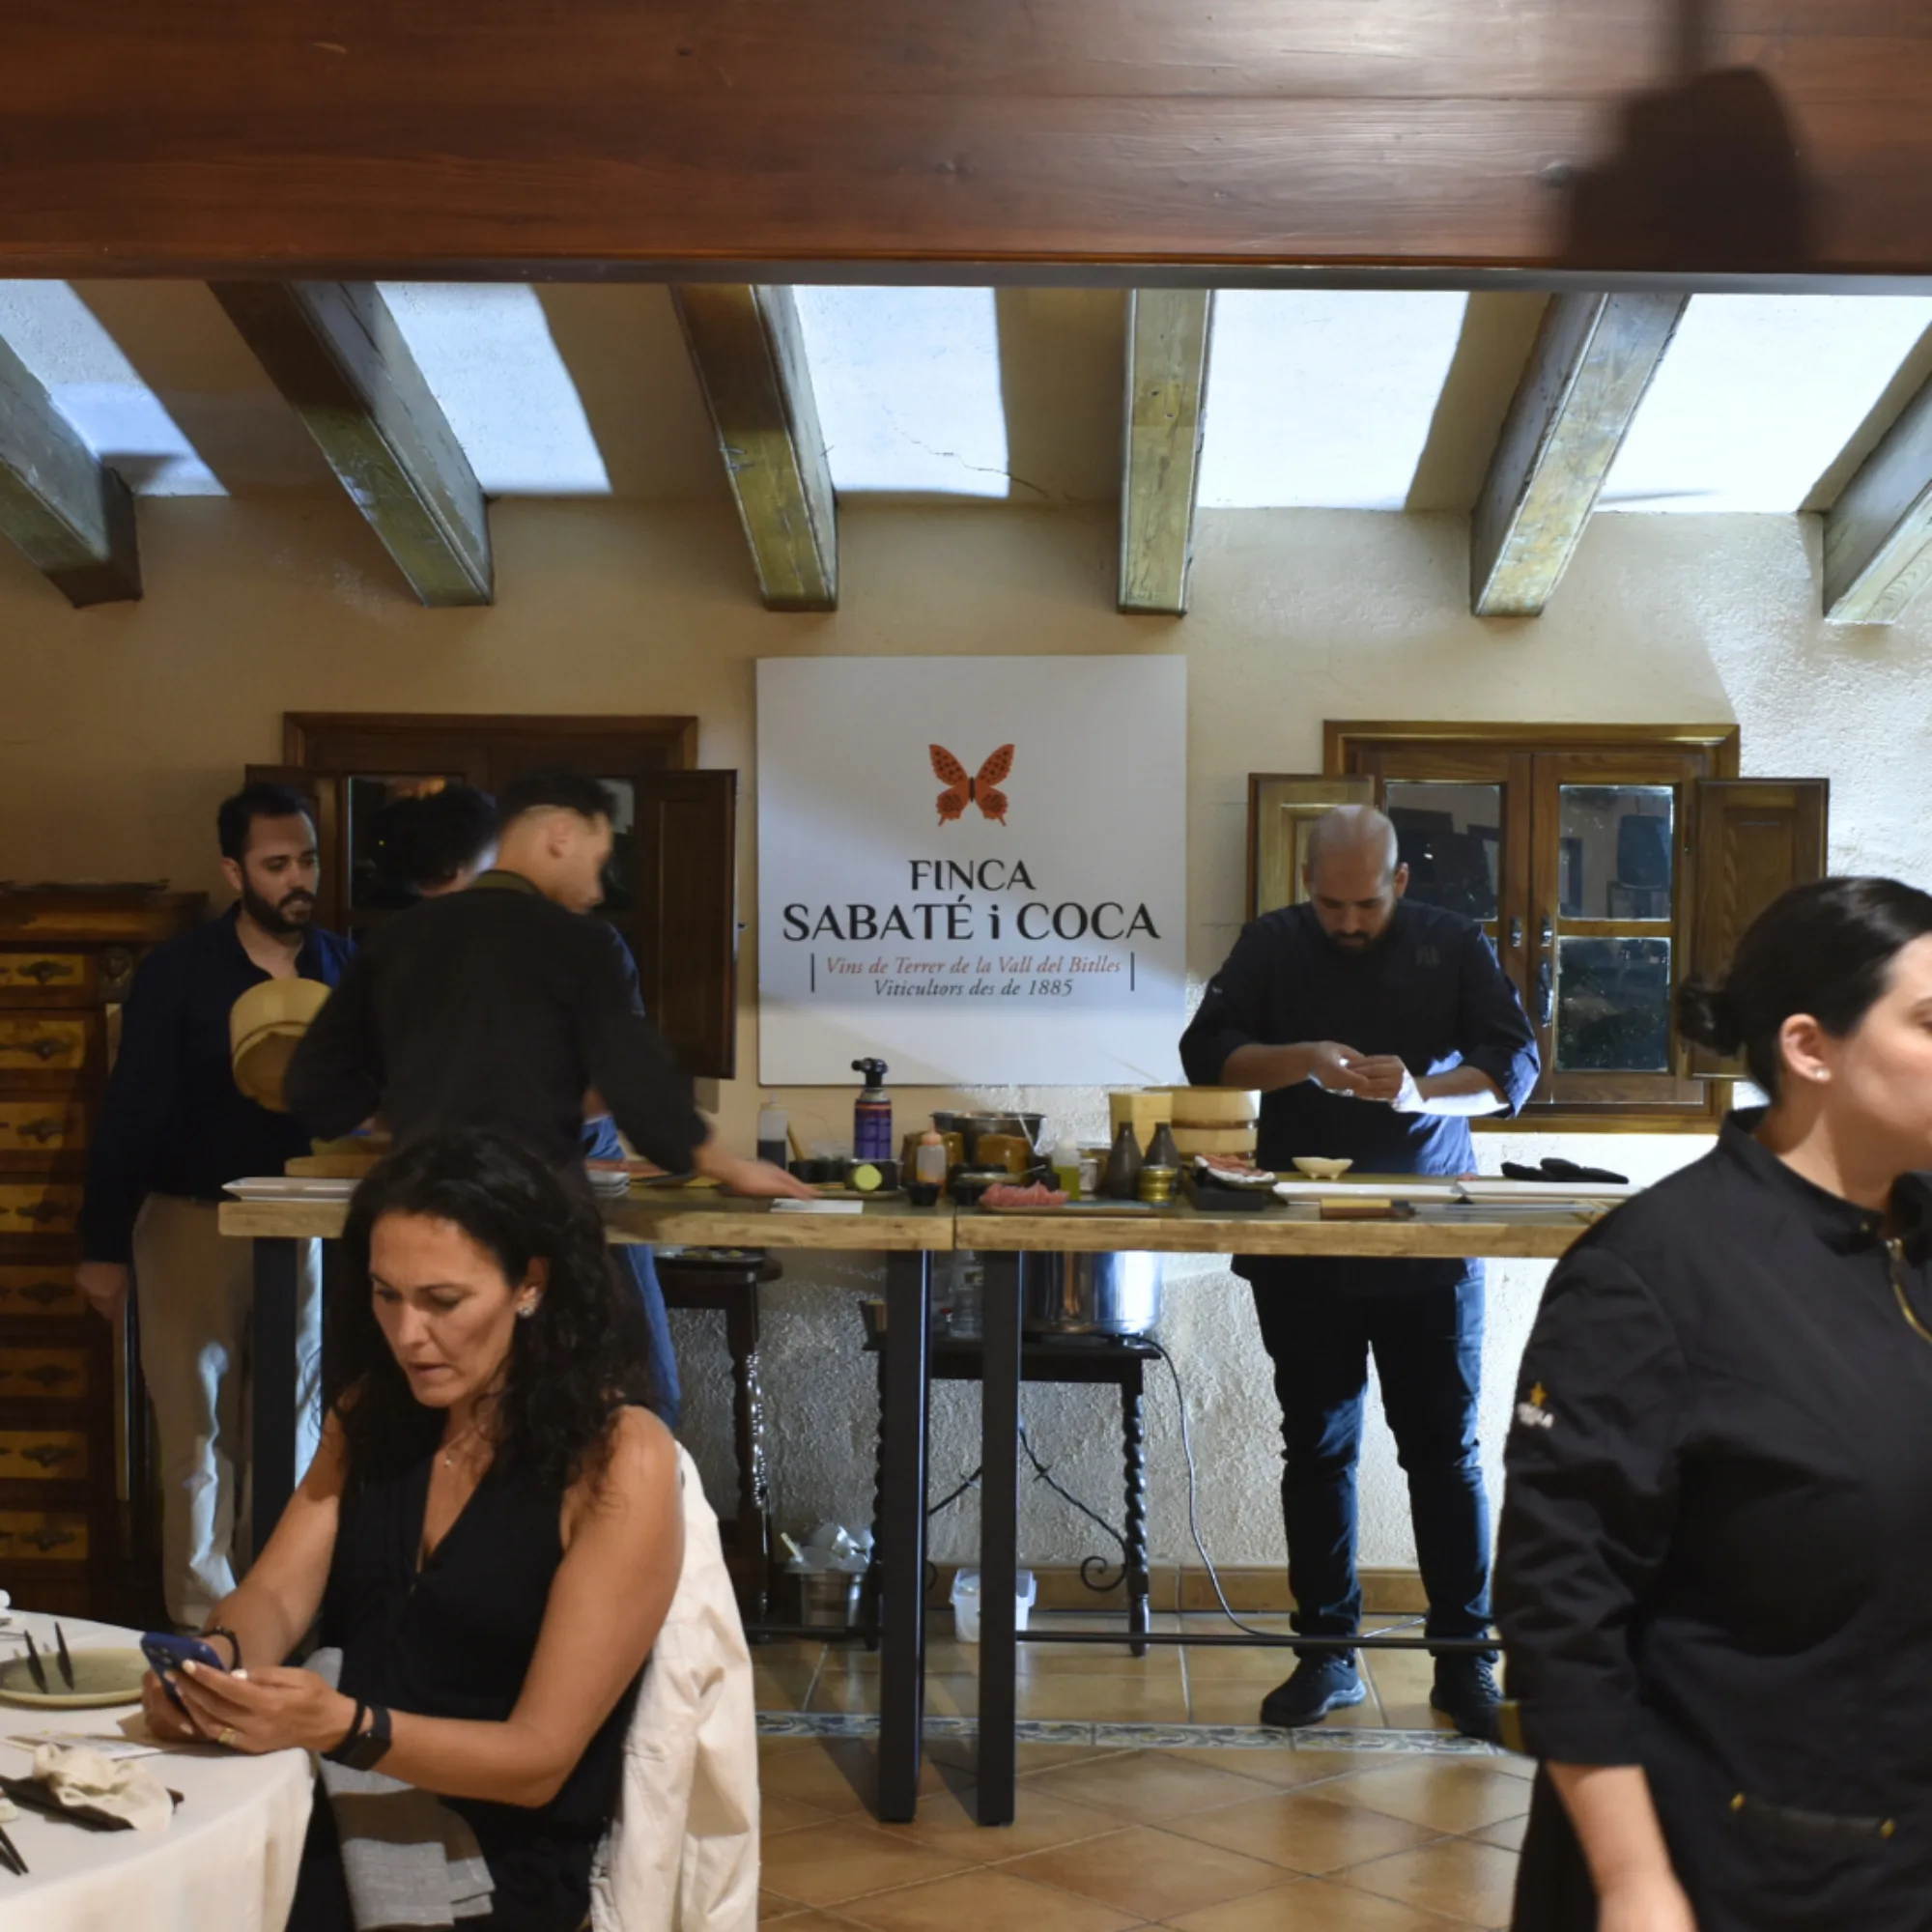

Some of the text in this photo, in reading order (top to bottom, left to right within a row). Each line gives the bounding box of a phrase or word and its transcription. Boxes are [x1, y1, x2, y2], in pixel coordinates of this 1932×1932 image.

[908, 859, 1037, 891] FINCA
[782, 895, 1161, 941] SABATÉ i COCA
[827, 955, 1122, 974] Vins de Terrer de la Vall del Bitlles
[874, 978, 1074, 997] Viticultors des de 1885
